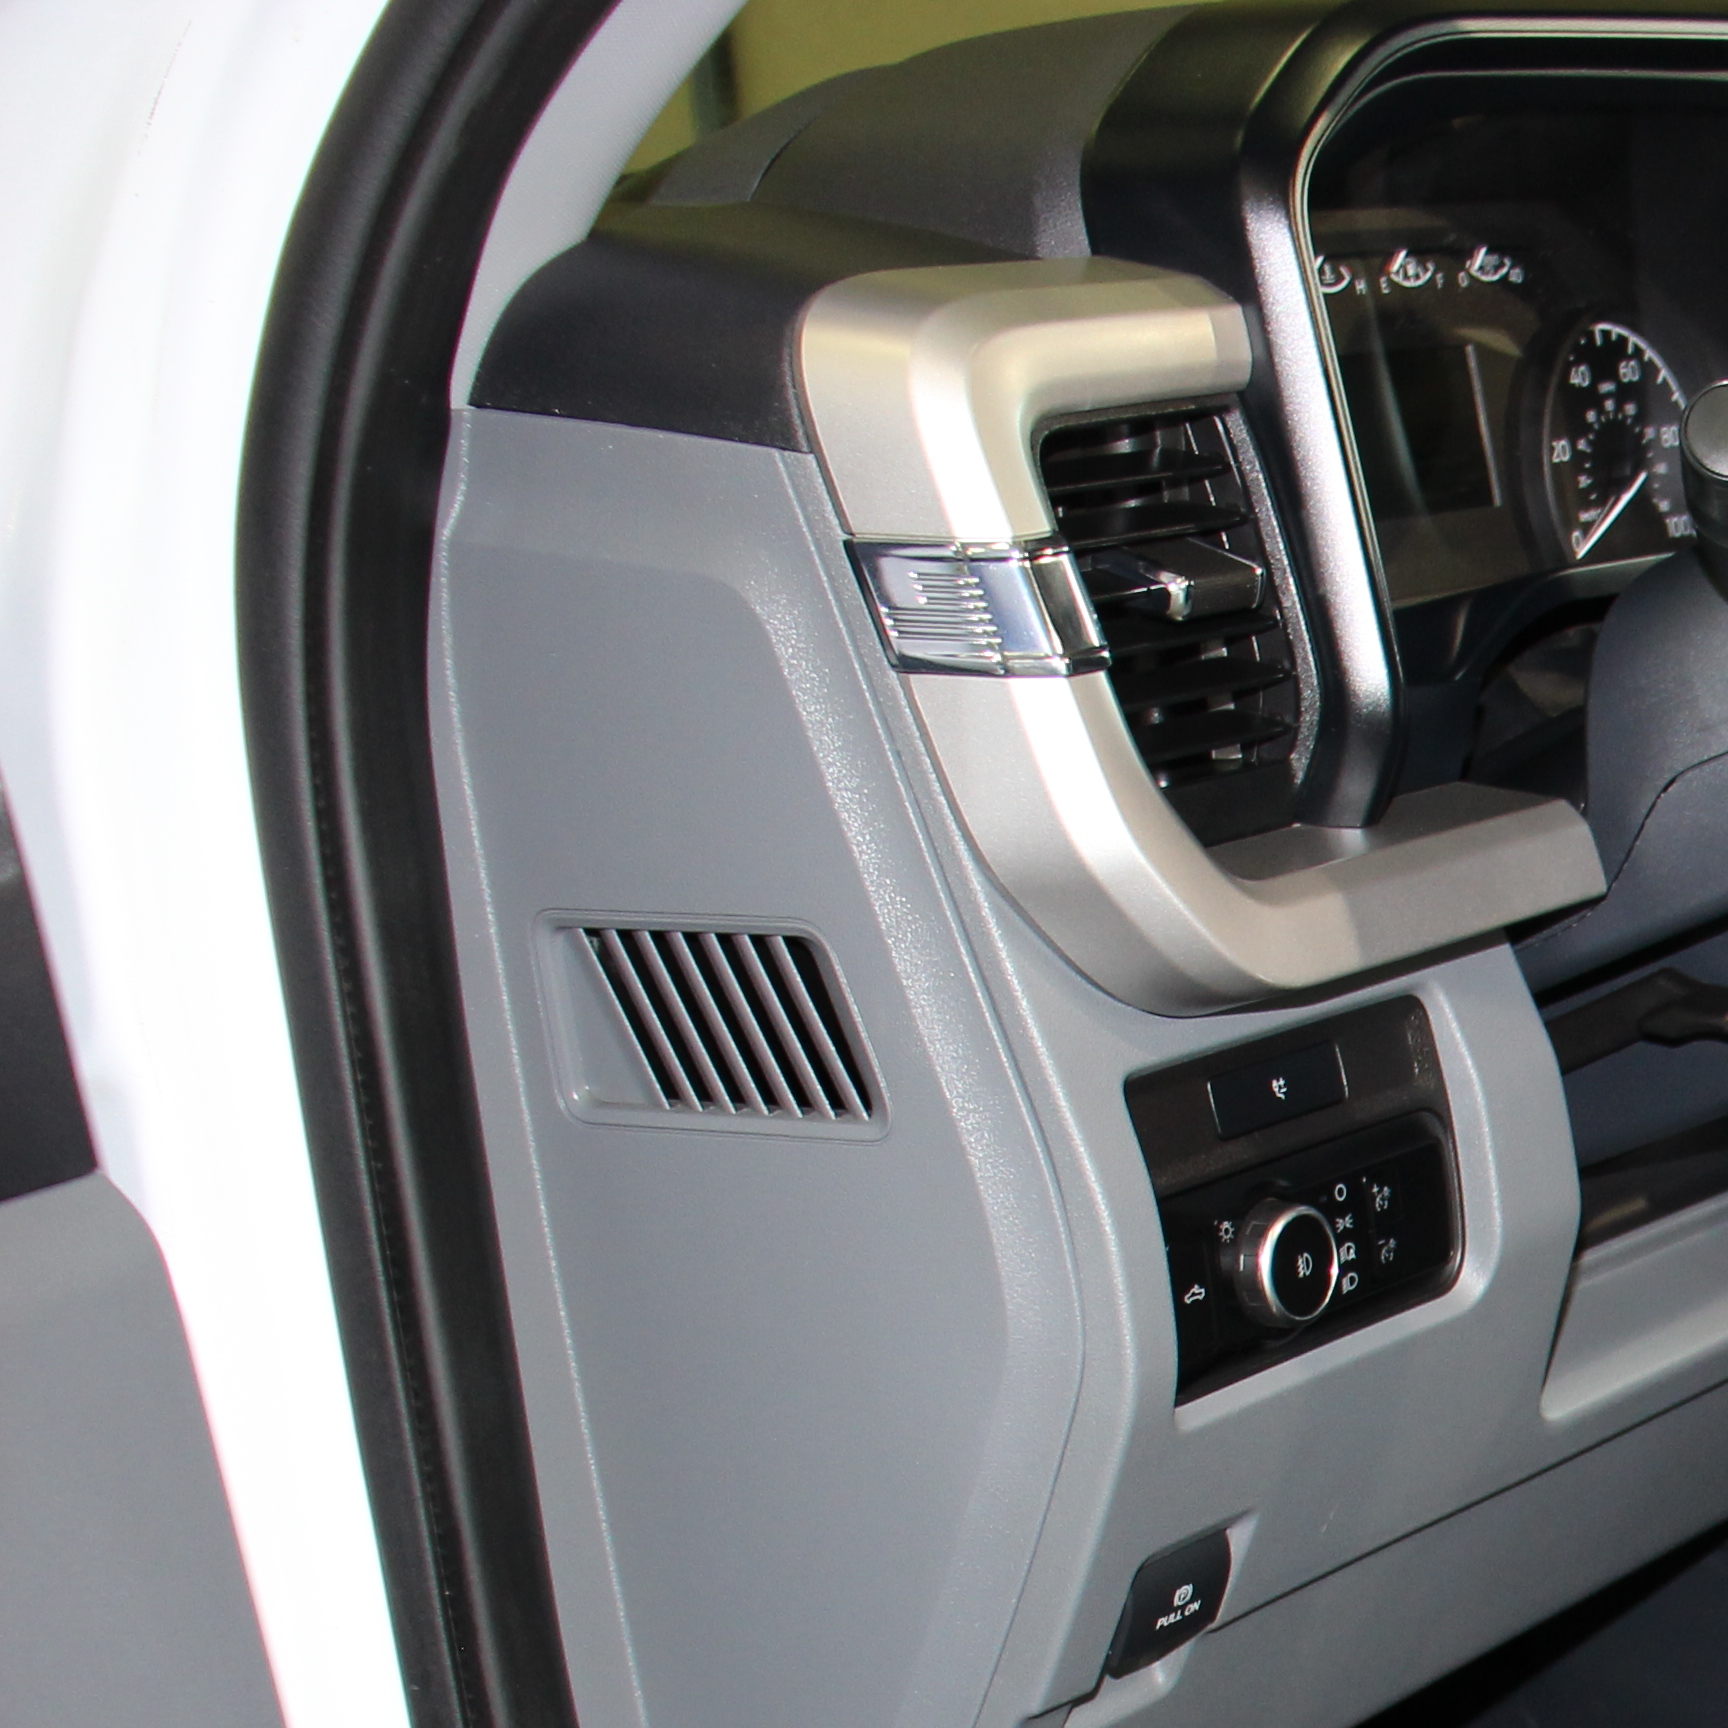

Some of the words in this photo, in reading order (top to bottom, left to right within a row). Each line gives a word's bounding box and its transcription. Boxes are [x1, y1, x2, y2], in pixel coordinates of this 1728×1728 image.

[1355, 278, 1367, 295] H
[1379, 276, 1391, 295] E
[1569, 363, 1592, 388] 40
[1618, 358, 1642, 383] 60
[1659, 425, 1680, 449] 80
[1551, 437, 1572, 463] 20
[1155, 1609, 1183, 1631] PULL
[1184, 1599, 1202, 1616] ON
